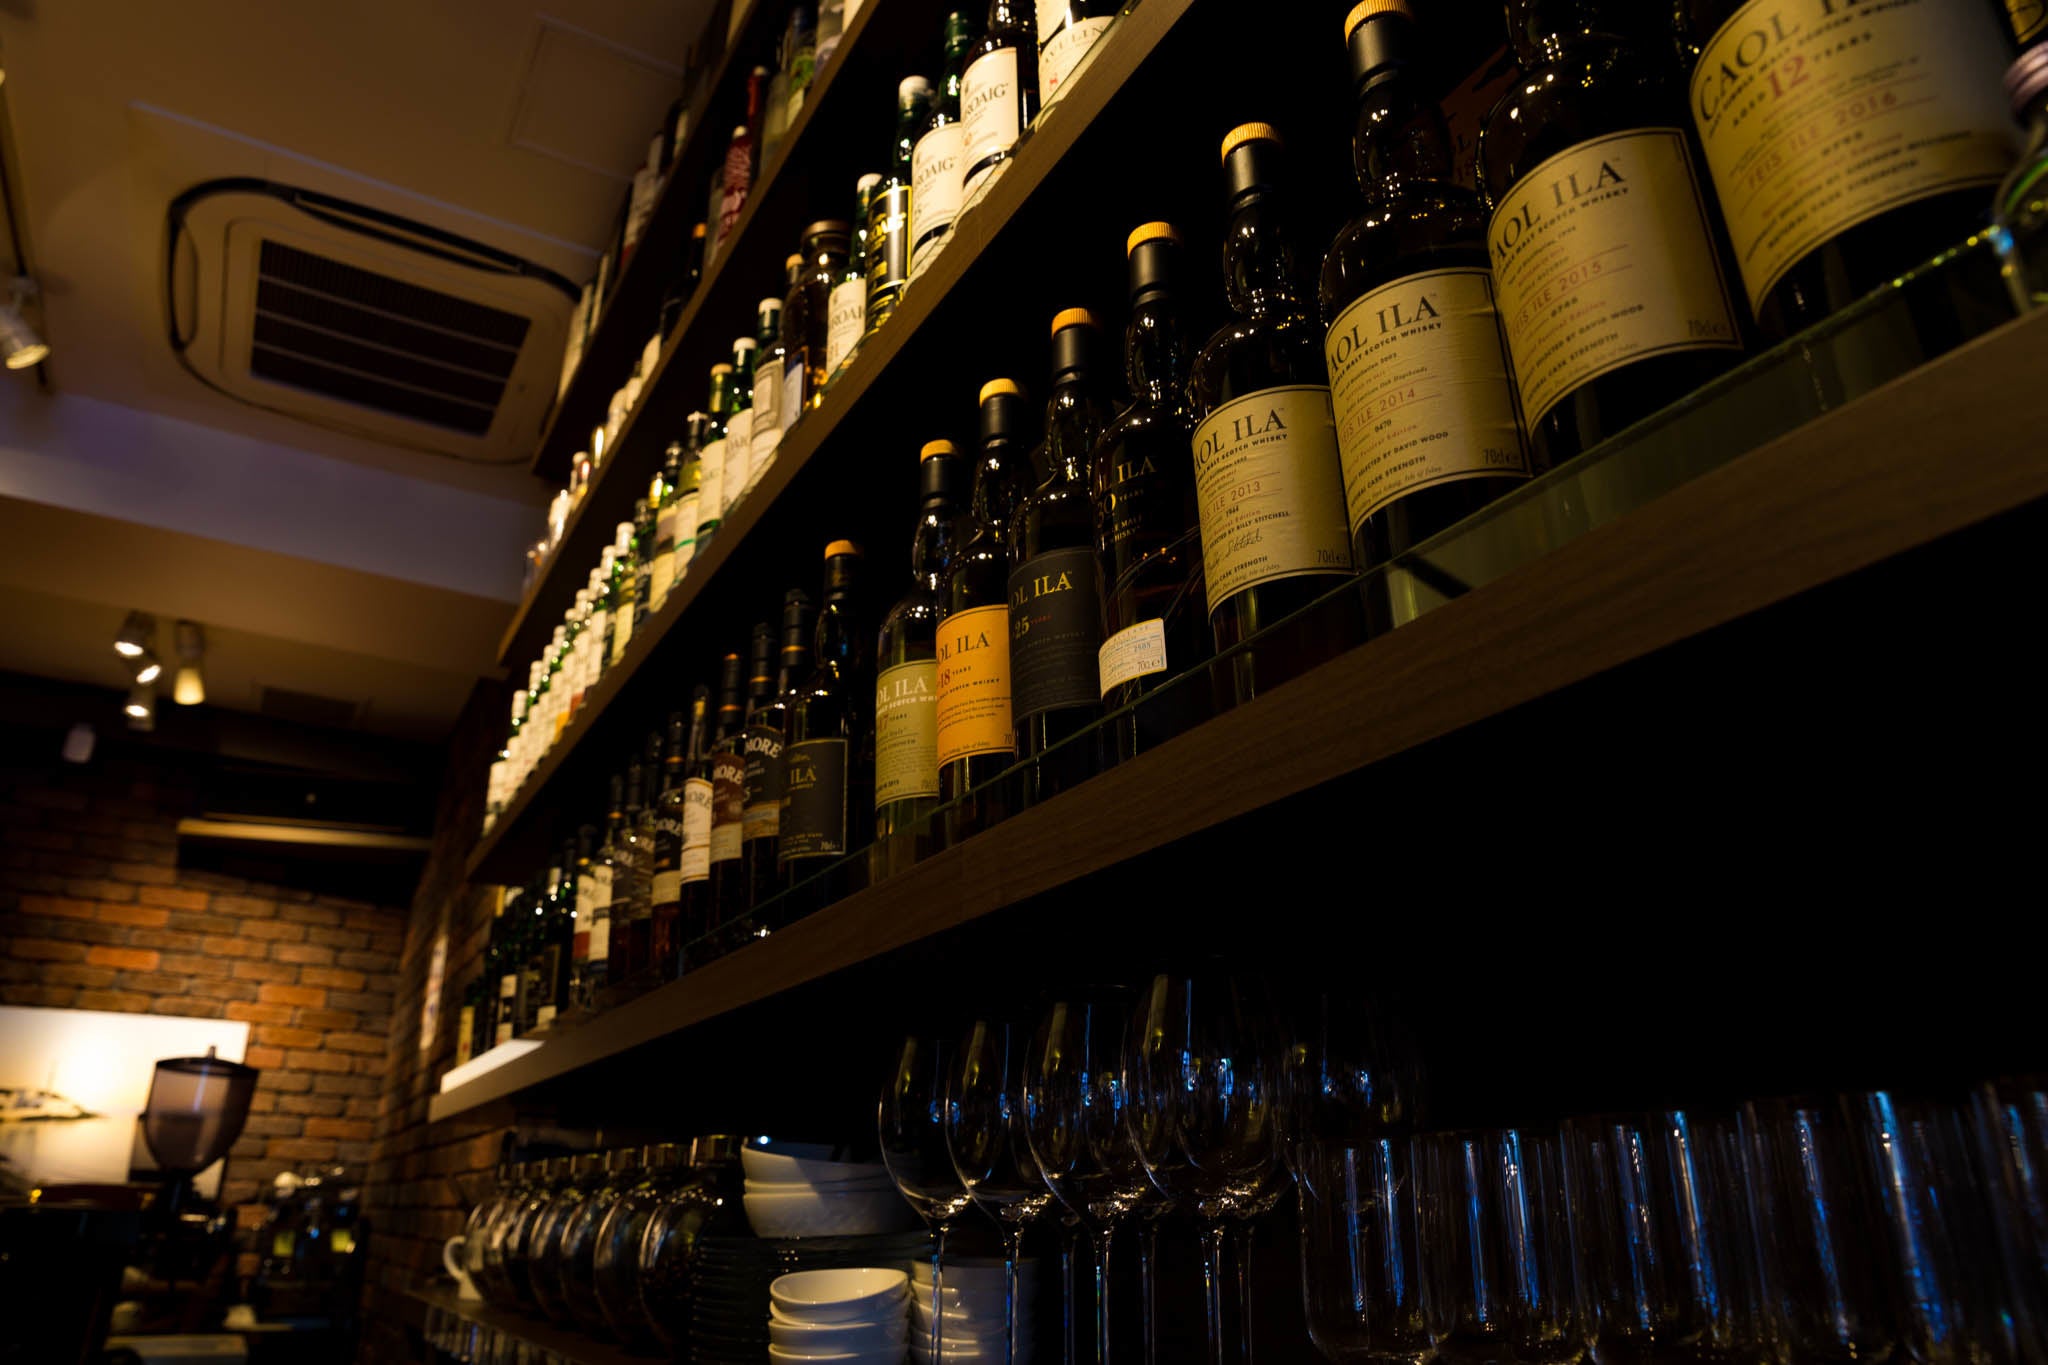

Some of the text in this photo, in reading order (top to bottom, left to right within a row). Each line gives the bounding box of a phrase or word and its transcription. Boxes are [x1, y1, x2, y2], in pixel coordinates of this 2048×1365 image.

[1699, 11, 1801, 121] CAOL
[1768, 55, 1811, 98] 12
[1833, 91, 1897, 124] 2016
[1491, 160, 1625, 260] AOL ILA
[1560, 262, 1601, 292] 2015
[1328, 295, 1440, 374] AOL ILA
[1400, 321, 1442, 339] WHISKY
[1357, 408, 1372, 427] ILE
[1379, 388, 1415, 413] 2014
[1195, 408, 1287, 472] AOL ILA
[1251, 433, 1288, 447] WHISKY
[1393, 439, 1418, 454] DAVID
[1420, 431, 1449, 444] WOOD
[1117, 455, 1158, 484] ILA
[1384, 455, 1426, 477] STRENGTH
[1212, 495, 1227, 513] ILE
[1231, 480, 1261, 502] 2013
[1233, 555, 1268, 572] STRENGTH
[1033, 570, 1073, 599] ILA
[1014, 615, 1031, 640] 25
[956, 631, 991, 655] ILA
[896, 676, 929, 698] ILA
[940, 666, 951, 689] 18
[791, 765, 817, 785] ILA
